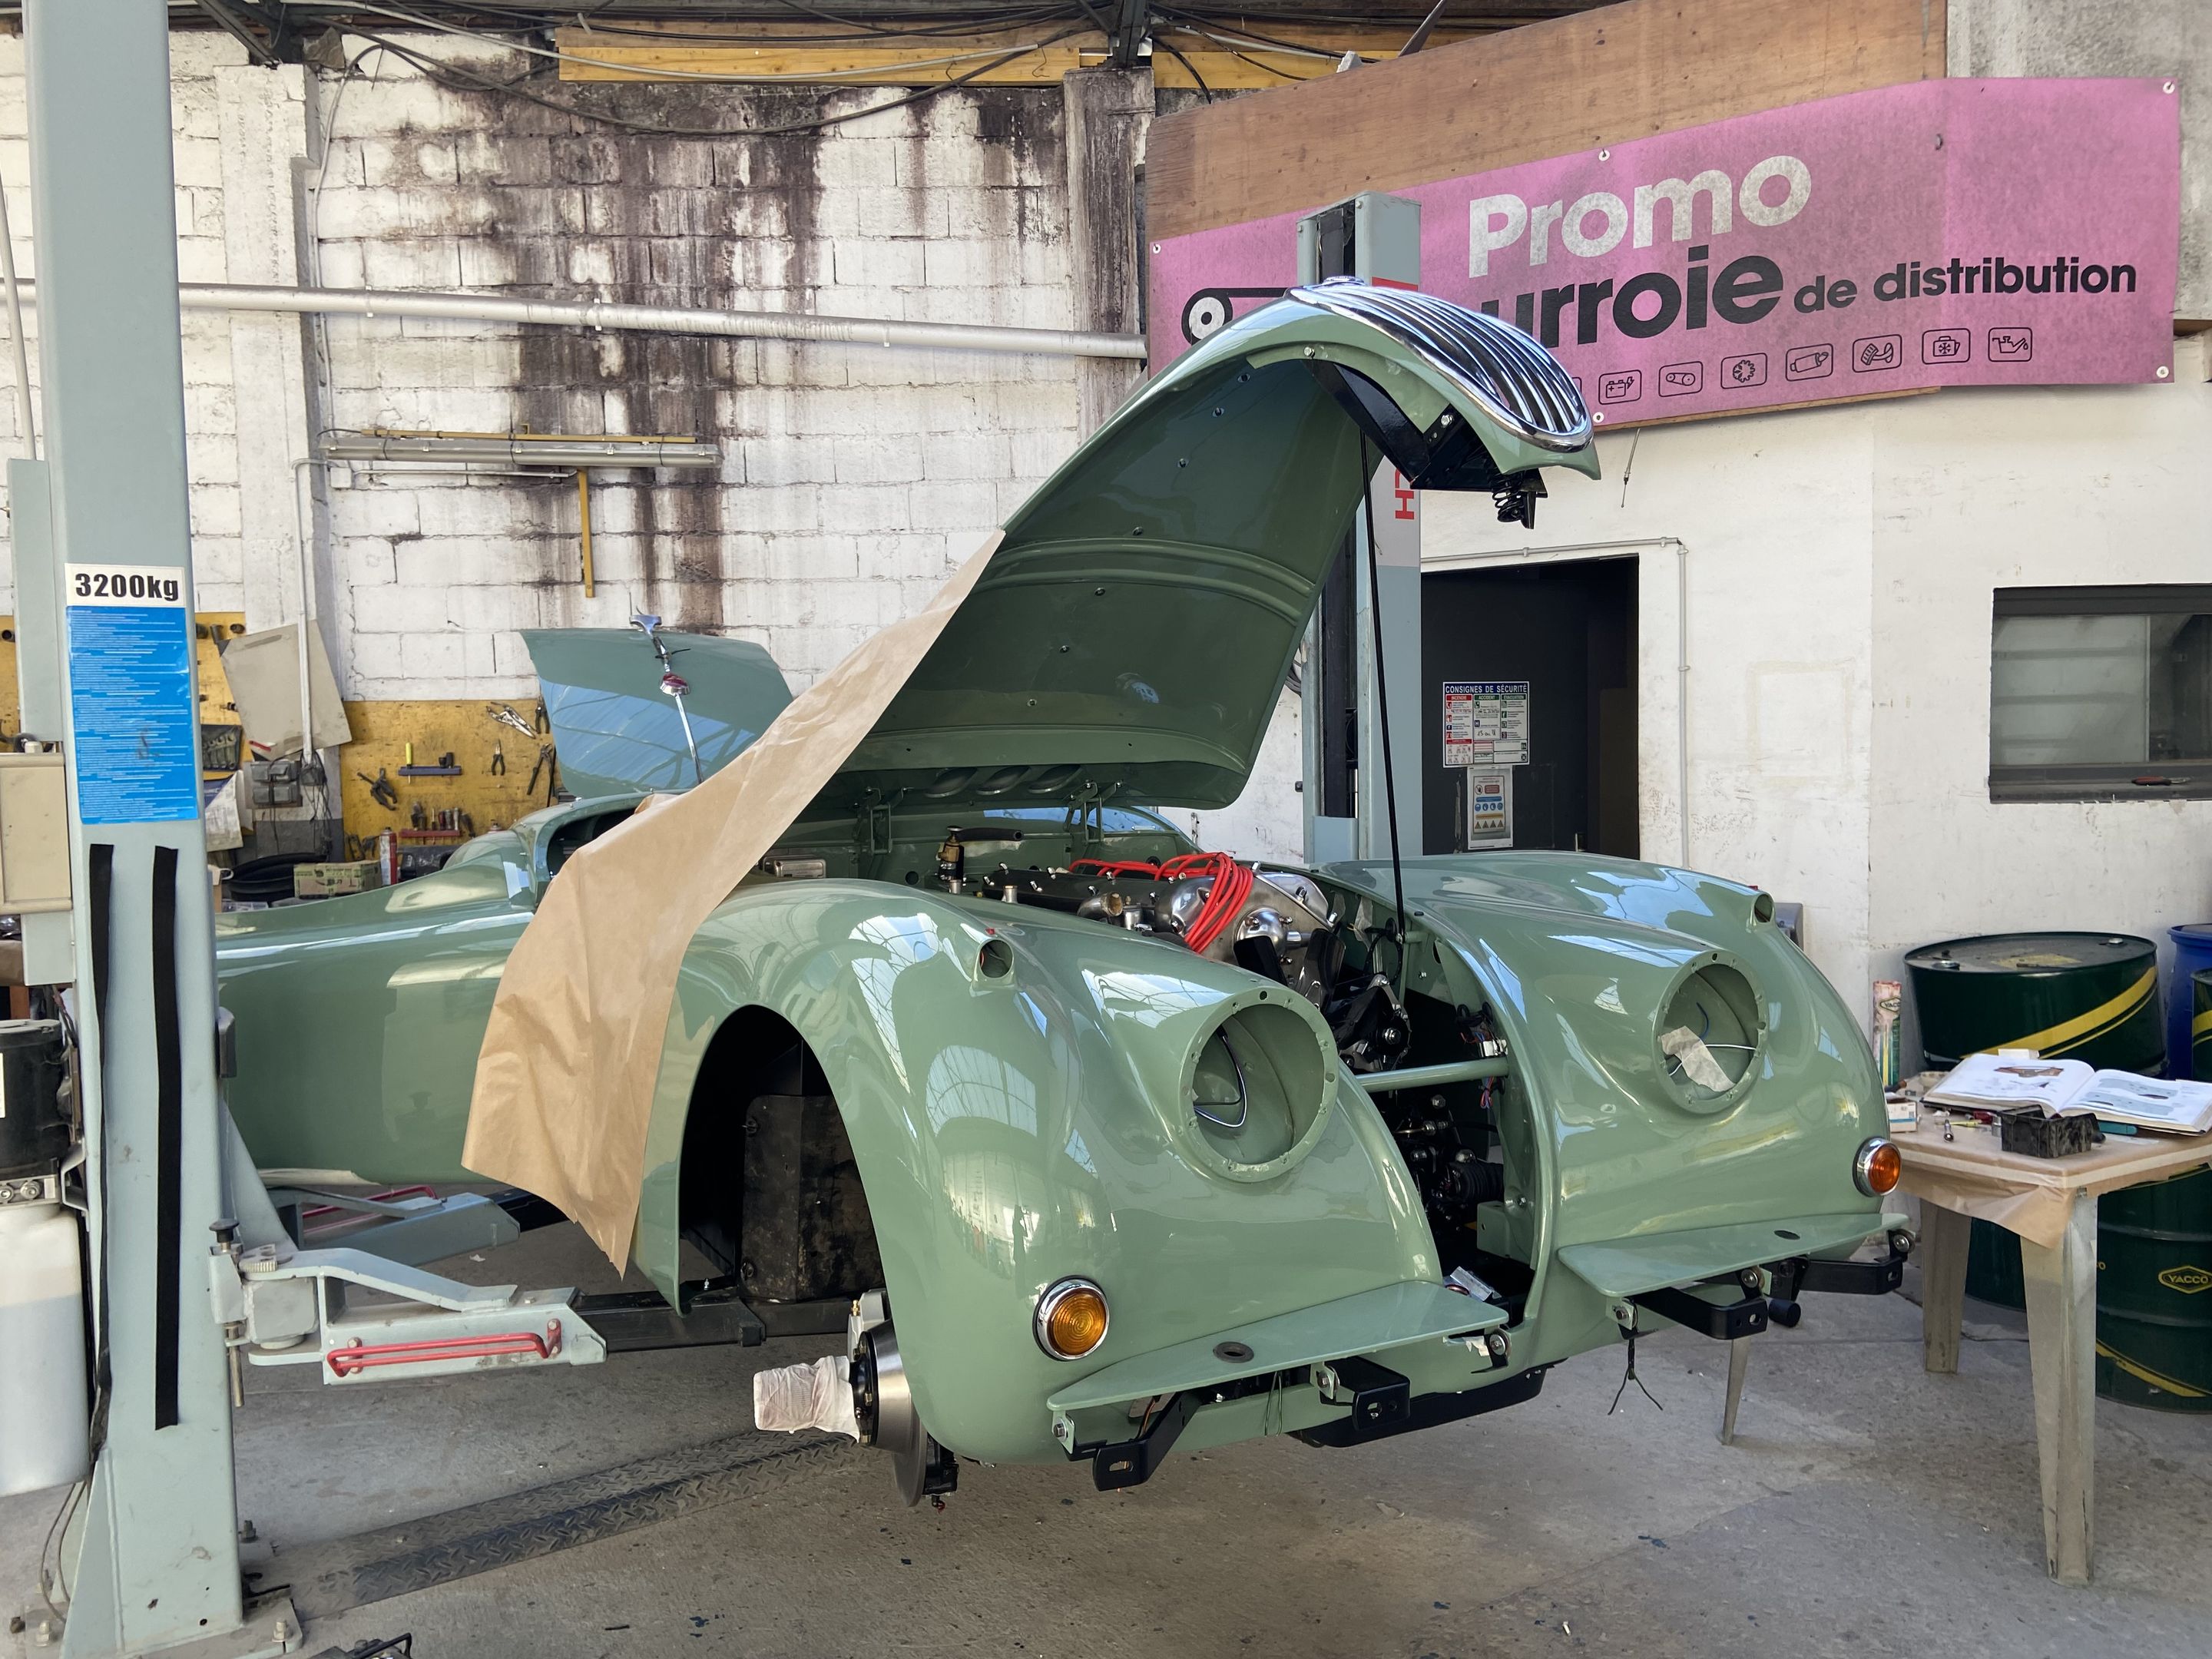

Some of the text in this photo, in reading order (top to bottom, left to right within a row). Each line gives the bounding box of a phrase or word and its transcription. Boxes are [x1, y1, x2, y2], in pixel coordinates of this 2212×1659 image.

[1469, 155, 1812, 279] Promo
[1793, 275, 1858, 313] de
[1873, 256, 2137, 302] distribution
[75, 573, 179, 602] 3200kg
[1445, 685, 1482, 694] CONSIGNES
[1496, 684, 1528, 693] SÉCURITÉ
[2167, 1274, 2209, 1284] YACCO
